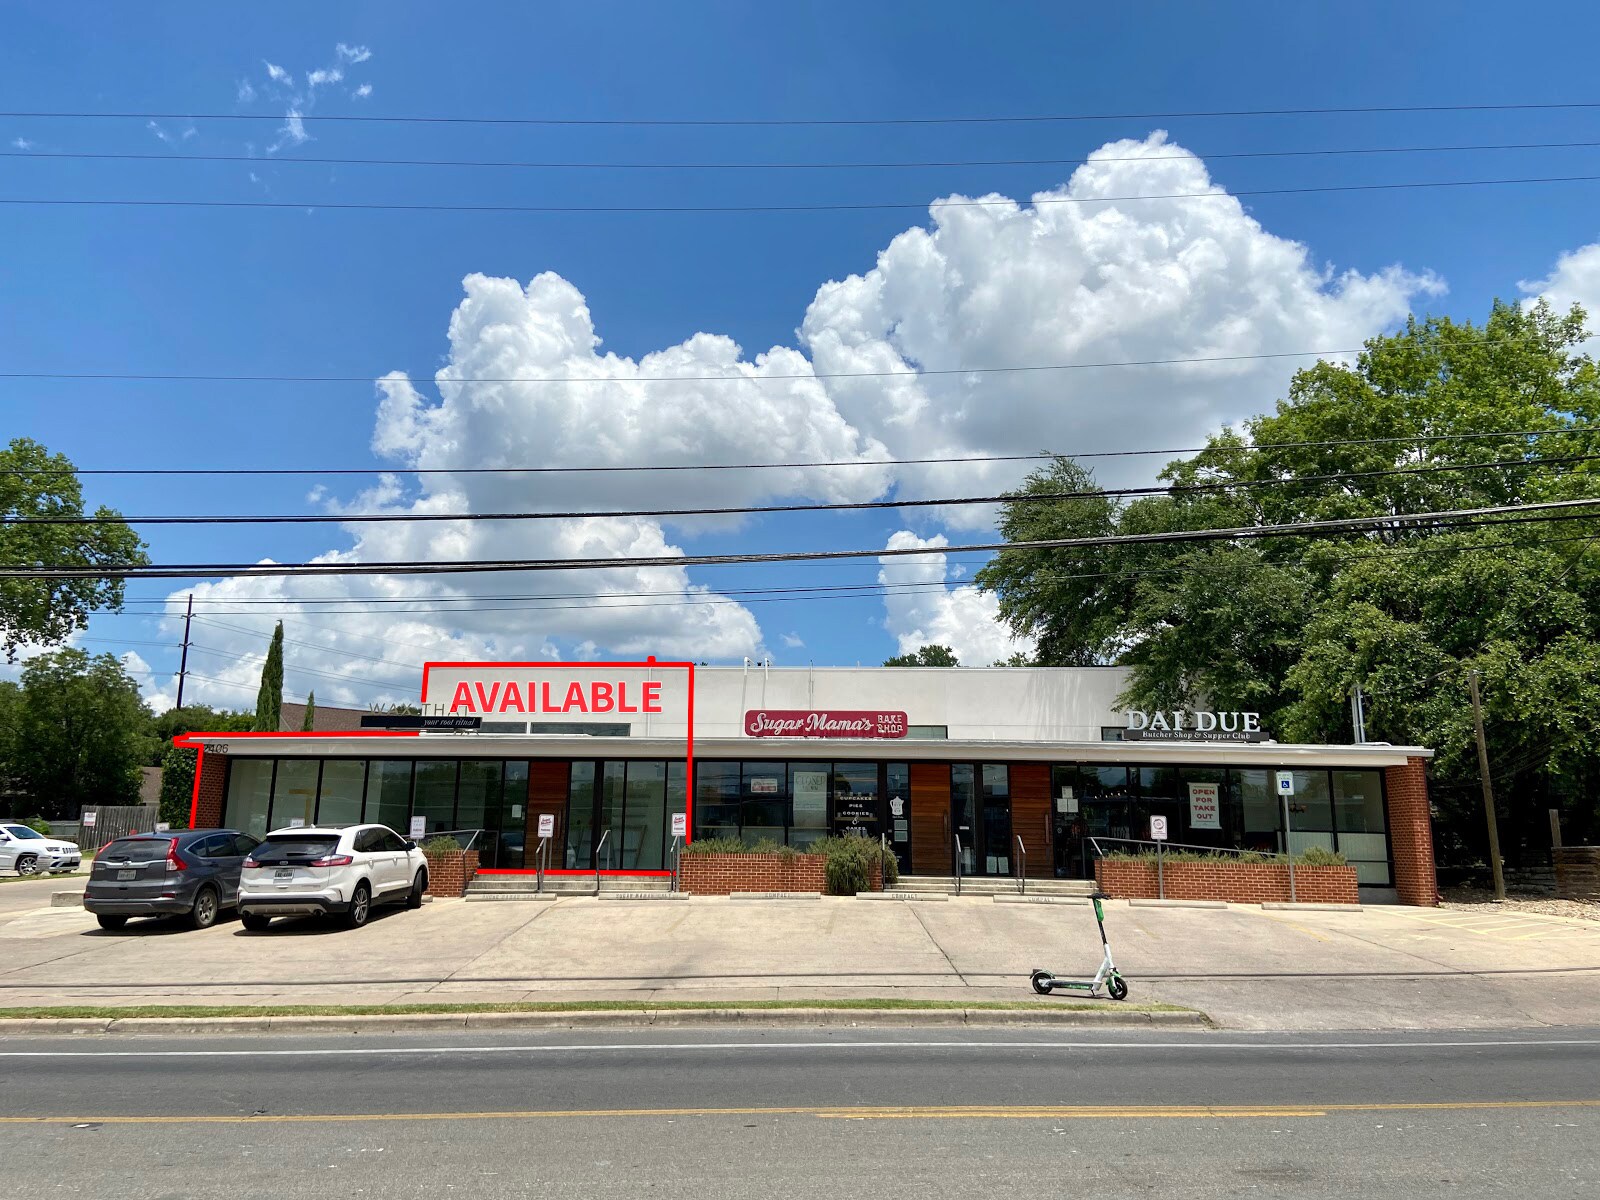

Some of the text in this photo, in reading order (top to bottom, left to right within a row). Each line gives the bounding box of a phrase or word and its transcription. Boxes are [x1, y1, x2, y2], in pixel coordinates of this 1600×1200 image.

[369, 703, 413, 717] WAX
[423, 719, 440, 728] your
[749, 712, 875, 736] Sugar Mama's
[876, 714, 903, 724] BAKE
[1126, 710, 1261, 732] DAI DUE
[876, 724, 904, 734] SHOP
[1142, 731, 1173, 739] Butcher
[1173, 731, 1193, 740] Shop
[1202, 732, 1231, 741] Supper
[1232, 732, 1251, 740] Club
